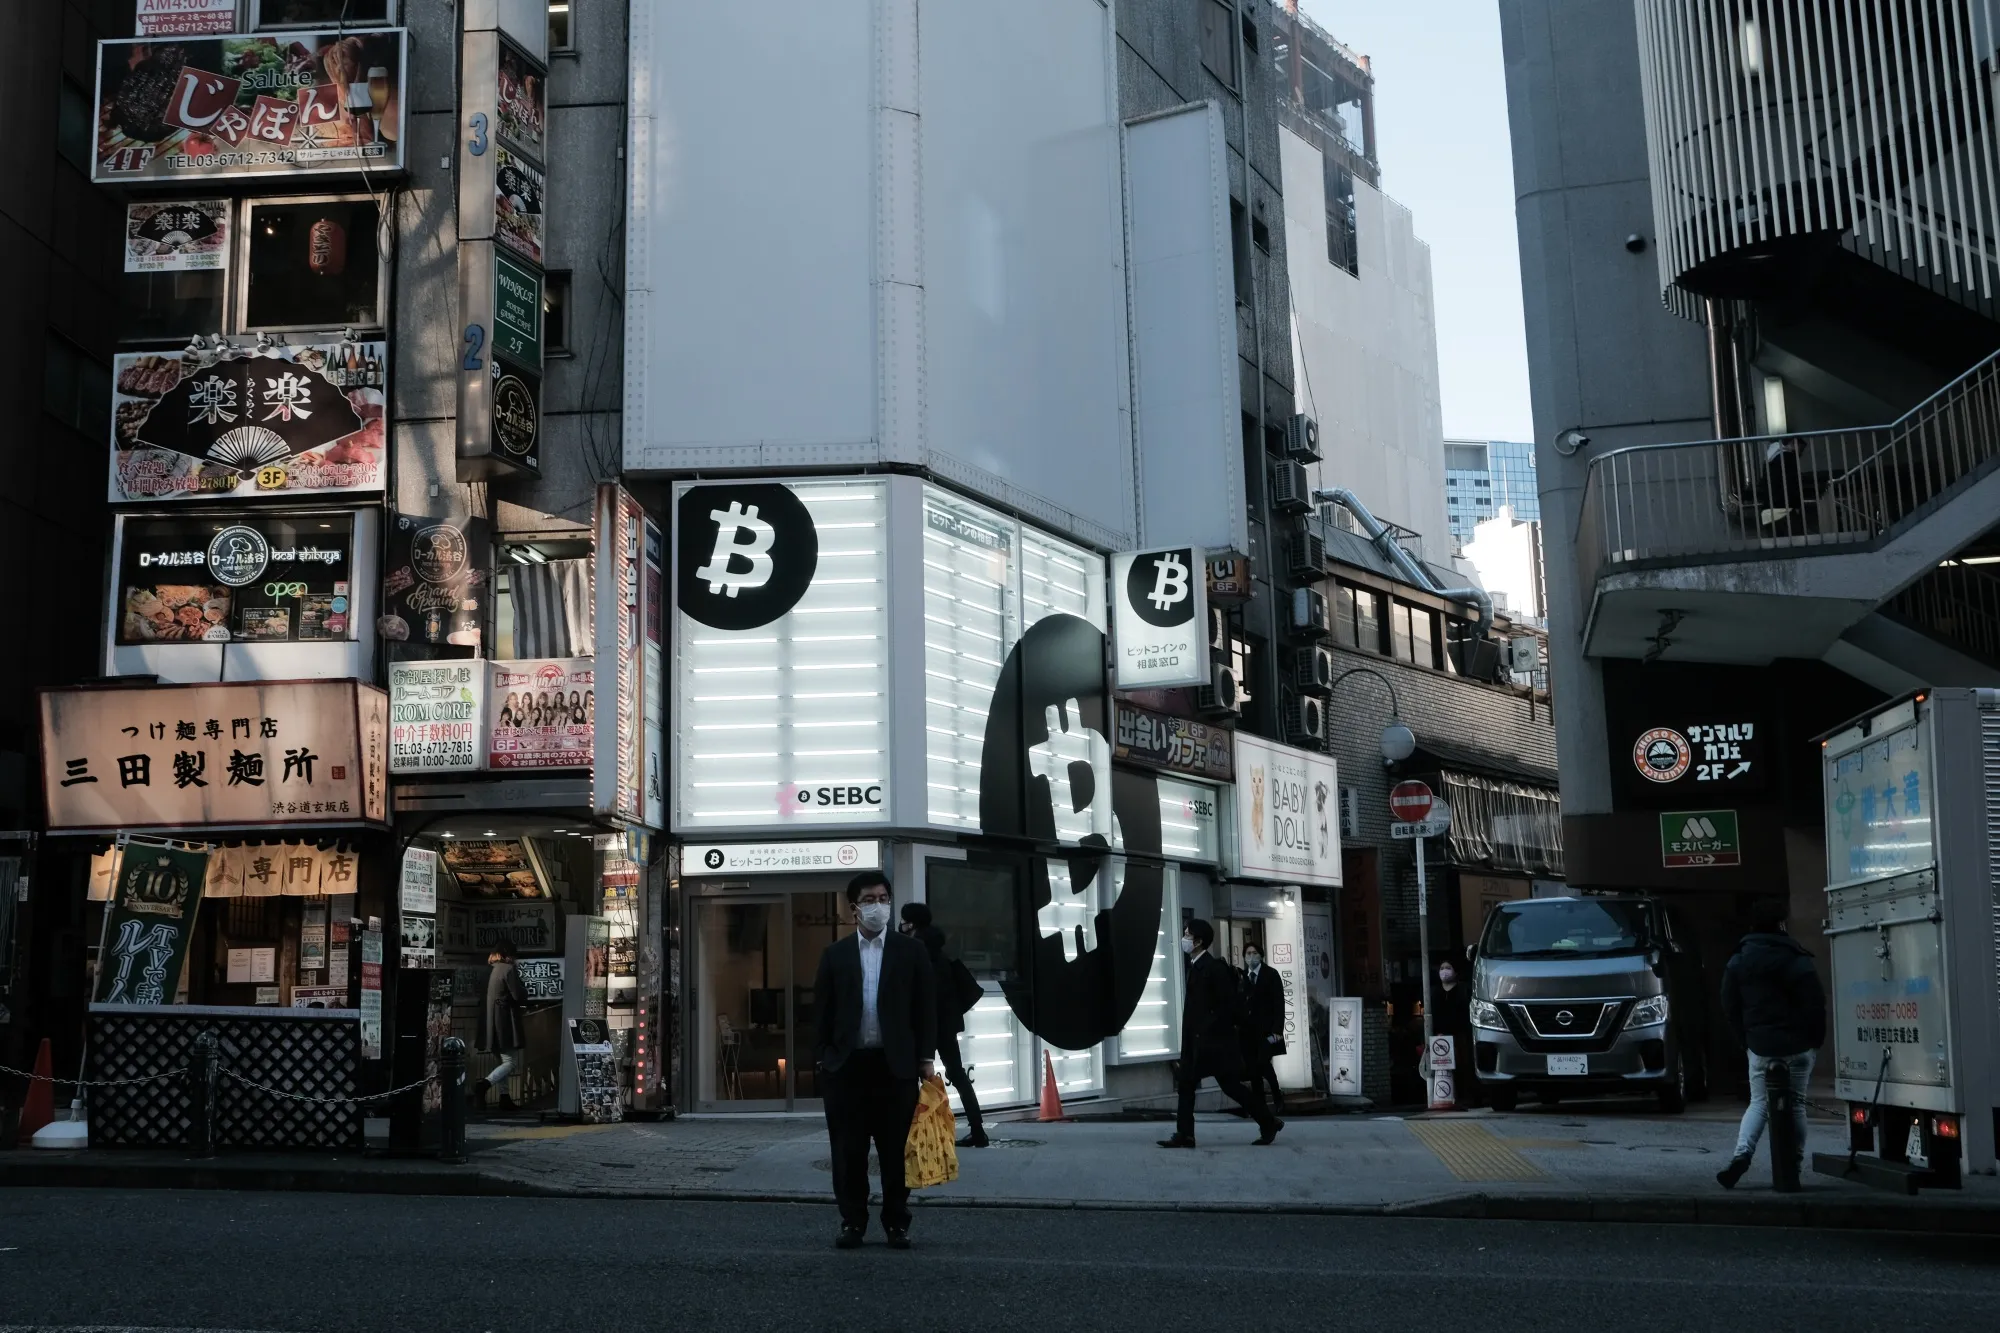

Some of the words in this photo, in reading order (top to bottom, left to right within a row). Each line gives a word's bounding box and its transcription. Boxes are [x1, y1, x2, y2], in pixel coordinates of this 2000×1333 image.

[241, 69, 312, 89] Salute
[179, 73, 337, 142] じゃぽん
[468, 111, 488, 156] 3
[103, 146, 154, 172] 4F
[166, 150, 294, 168] TEL03-6712-7342
[154, 211, 173, 230] 楽
[182, 210, 200, 229] 楽
[499, 273, 534, 304] WINKLE
[464, 323, 486, 371] 2
[509, 336, 524, 354] 2F
[188, 375, 238, 424] 楽
[246, 378, 255, 419] らくらく
[261, 371, 313, 422] 楽
[262, 471, 281, 485] 3F
[140, 551, 206, 567] ローカル渋谷
[211, 553, 265, 566] ローカル渋谷
[271, 546, 296, 561] local
[298, 545, 342, 565] shibuya
[264, 581, 308, 606] open
[414, 581, 461, 601] Grand
[1216, 582, 1233, 590] 6F
[406, 593, 460, 614] Opening
[1127, 643, 1187, 656] ビットコインの
[1137, 656, 1179, 669] 相談窓口
[393, 667, 471, 685] お部屋探しは
[394, 686, 456, 701] ルームコア
[393, 703, 430, 722] ROOM
[432, 702, 473, 721] CORE
[121, 717, 279, 741] つけ麺専門店
[394, 722, 473, 743] 仲介手数料0円
[1191, 723, 1203, 737] 6F
[1687, 723, 1754, 743] サンマルク
[394, 741, 473, 755] TEL:03-6712-7815
[495, 740, 516, 750] 6F
[1704, 742, 1742, 761] カフェ
[60, 747, 319, 789] 三田製麺所
[393, 756, 420, 768] 営業時間
[1696, 763, 1725, 781] 2F
[817, 786, 882, 806] SEBC
[1272, 777, 1308, 815] BABY
[272, 800, 350, 814] 渋谷道玄坂店
[1194, 800, 1213, 817] SEBC
[1273, 814, 1311, 851] DOLL
[1394, 824, 1431, 836] 自転車を除く
[1671, 840, 1732, 853] モスバーガー
[730, 855, 832, 867] ビットコインの相談窓口
[1687, 856, 1704, 864] 入口
[142, 870, 177, 900] 10
[1281, 970, 1294, 1007] BABY
[1856, 1001, 1918, 1020] 03-3857-0088
[1284, 1011, 1296, 1048] DOLL
[944, 1066, 975, 1087] SC
